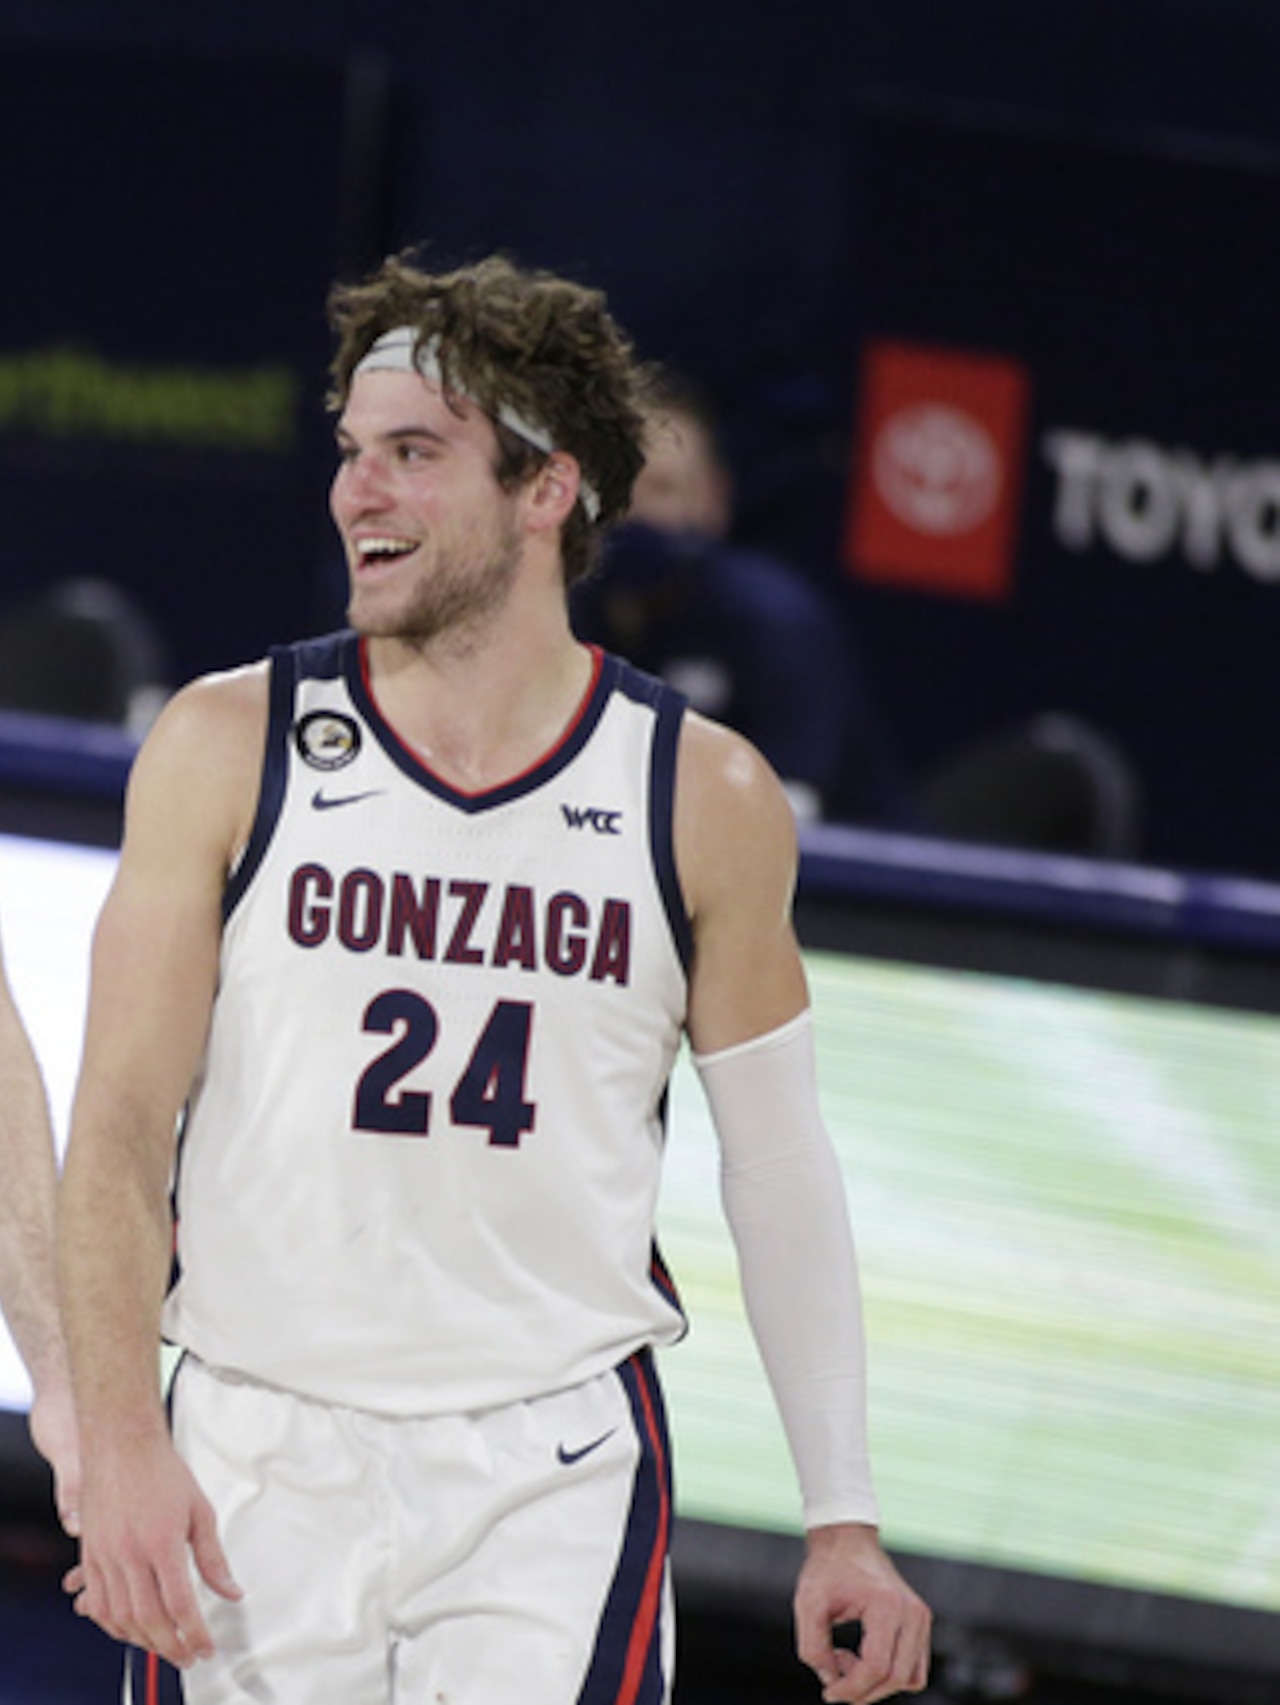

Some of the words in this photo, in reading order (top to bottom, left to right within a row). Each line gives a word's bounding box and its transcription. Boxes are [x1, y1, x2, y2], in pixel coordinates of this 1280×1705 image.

[560, 803, 623, 835] WCC
[286, 863, 632, 987] GONZAGA
[351, 988, 536, 1148] 24
